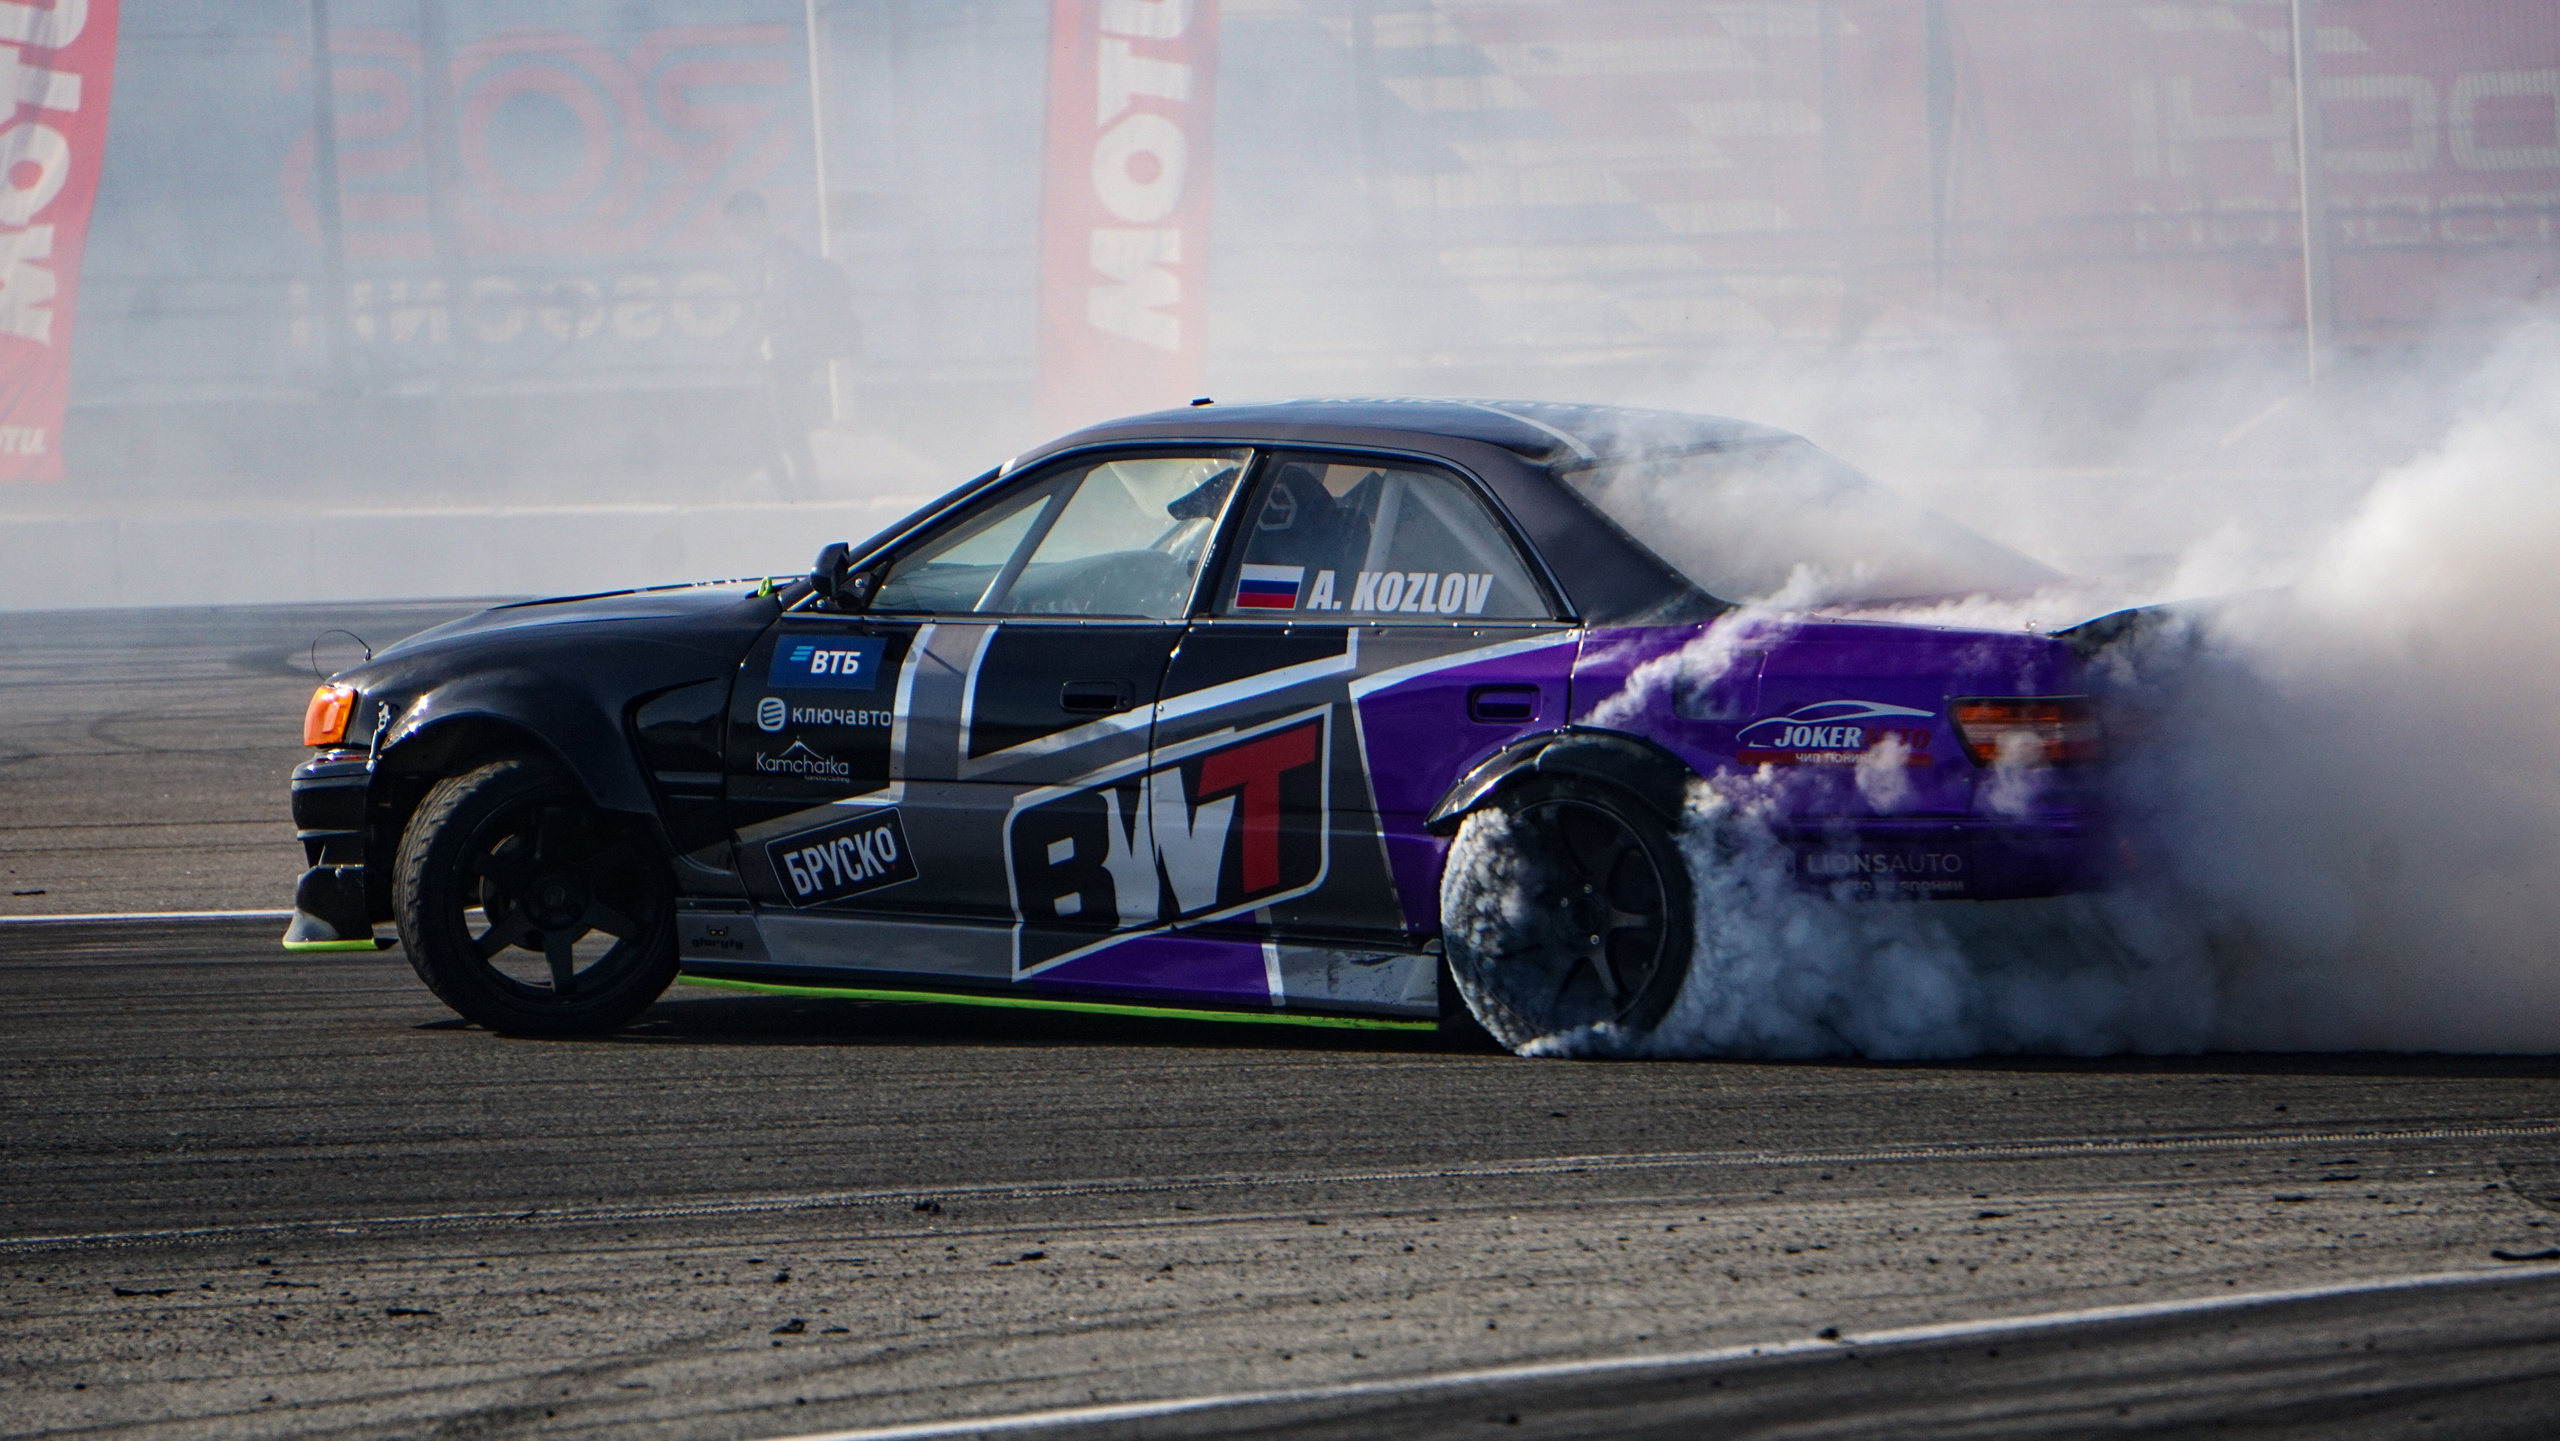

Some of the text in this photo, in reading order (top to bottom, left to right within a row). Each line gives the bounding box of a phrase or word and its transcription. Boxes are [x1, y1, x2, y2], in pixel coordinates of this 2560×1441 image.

[1306, 570, 1494, 614] A. KOZLOV
[810, 650, 861, 675] ВТБ
[756, 752, 849, 775] Kamchatka
[1011, 724, 1317, 931] BWT
[783, 826, 897, 896] БРУСКО
